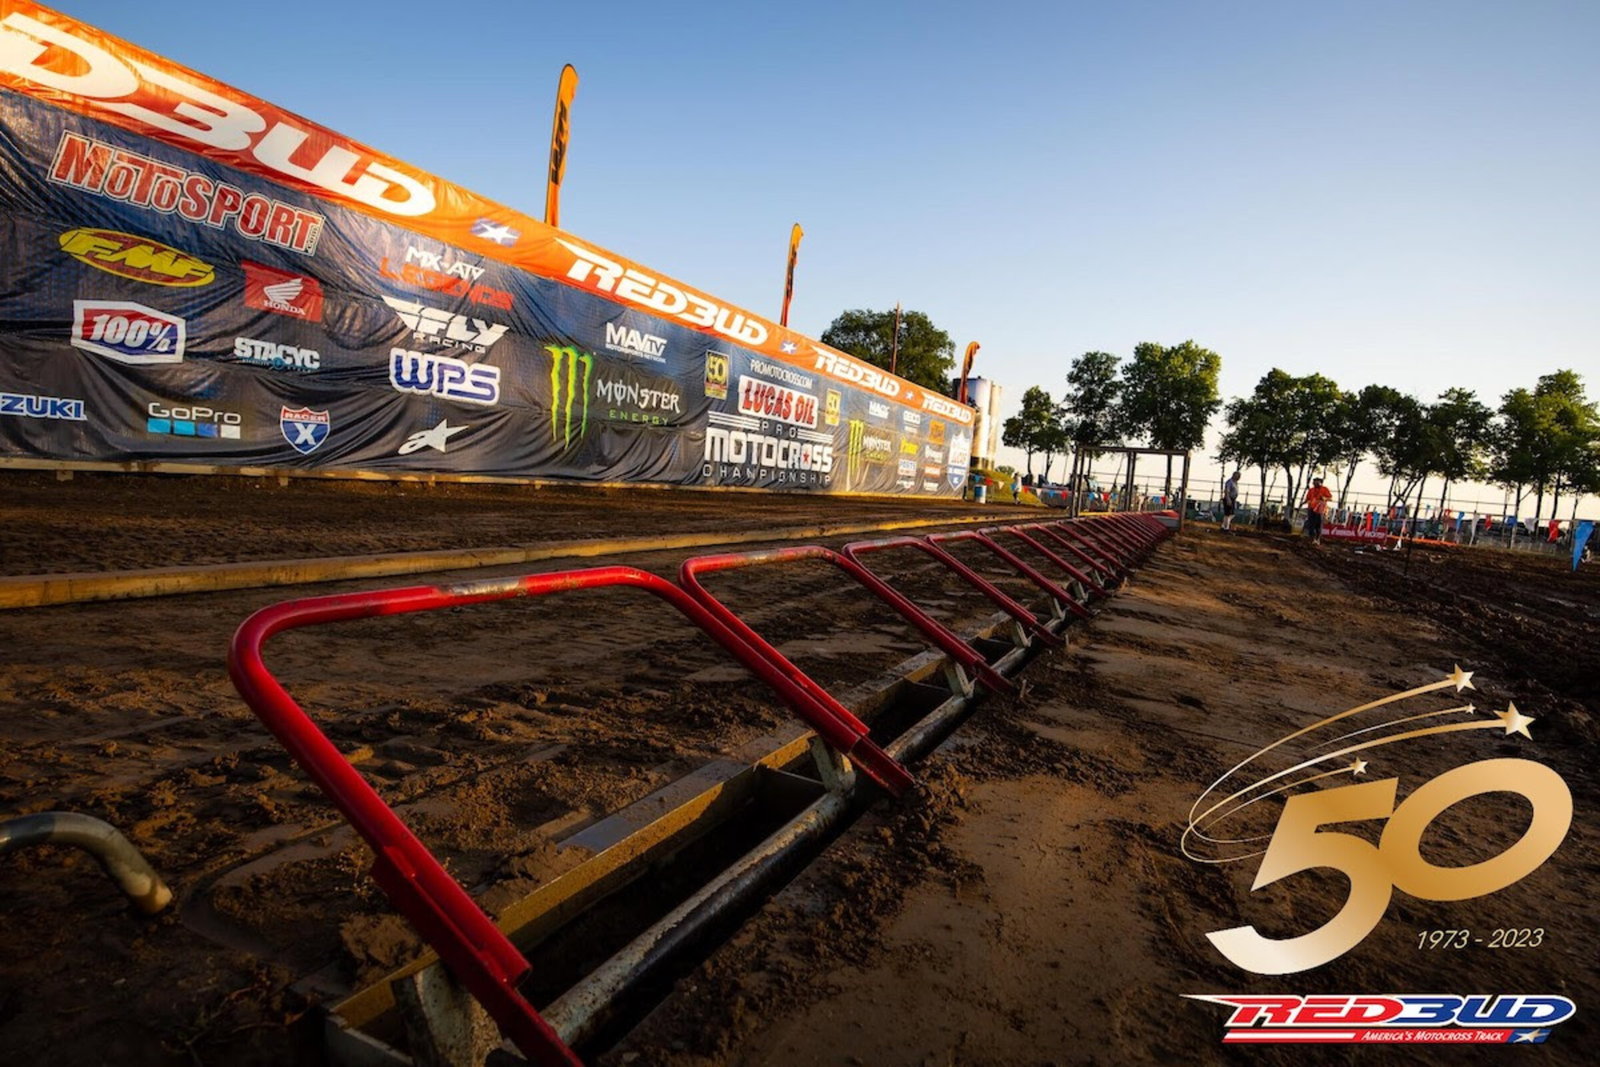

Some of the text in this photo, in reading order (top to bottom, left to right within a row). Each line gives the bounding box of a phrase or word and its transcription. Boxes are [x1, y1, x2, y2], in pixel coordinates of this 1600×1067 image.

[60, 231, 213, 278] FMF
[263, 300, 306, 315] HONDA
[555, 237, 769, 346] REDBUD
[90, 314, 171, 352] 100%
[381, 295, 510, 346] FLY
[234, 336, 320, 370] STACYC
[413, 332, 486, 353] RACING
[391, 350, 499, 404] WPS
[811, 346, 900, 396] REDBUD
[148, 402, 241, 424] GoPro
[596, 378, 681, 414] MONSTER
[742, 380, 793, 421] LUCAS
[794, 396, 816, 425] OIL
[284, 412, 327, 422] RACER
[294, 422, 317, 446] X
[609, 409, 669, 426] ENERGY
[762, 421, 798, 438] PRO
[704, 427, 833, 473] MOTOCROSS
